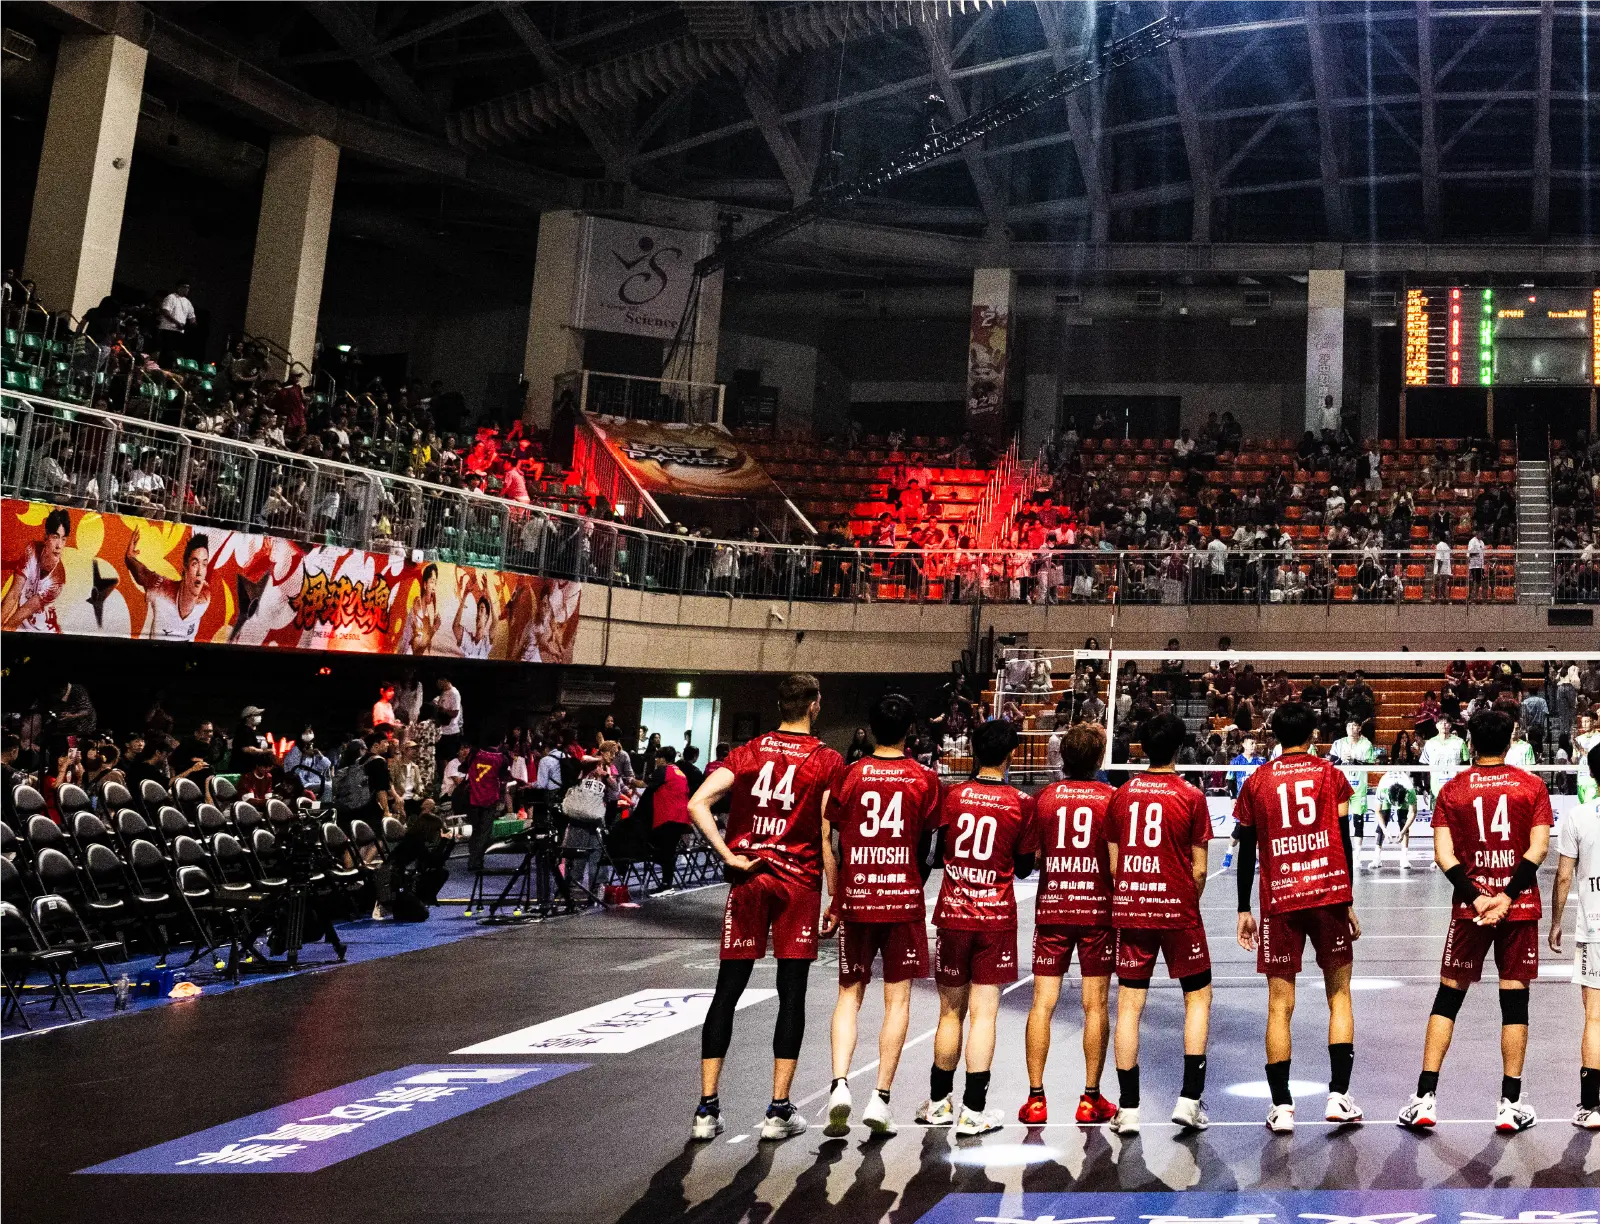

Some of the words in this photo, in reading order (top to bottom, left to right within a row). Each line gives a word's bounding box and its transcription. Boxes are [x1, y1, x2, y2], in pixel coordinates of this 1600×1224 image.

[626, 313, 678, 329] Science
[630, 442, 709, 457] EAST
[476, 763, 492, 782] 7
[751, 761, 797, 811] 44
[1277, 779, 1316, 828] 15
[860, 791, 904, 838] 34
[1473, 794, 1510, 842] 14
[1056, 806, 1092, 849] 19
[1127, 801, 1162, 847] 18
[955, 813, 997, 861] 20
[1272, 830, 1329, 857] DEGUCHI
[850, 847, 909, 865] MIYOSHI
[1046, 856, 1099, 873] HAMADA
[1124, 855, 1160, 873] KOGA
[1476, 850, 1515, 868] CHANG
[945, 864, 997, 885] SOMENO
[733, 937, 756, 948] Arai
[1037, 955, 1055, 965] Arai
[1120, 957, 1138, 967] Arai
[1272, 954, 1291, 964] Arai
[1453, 959, 1473, 969] Arai
[944, 966, 960, 976] Arai
